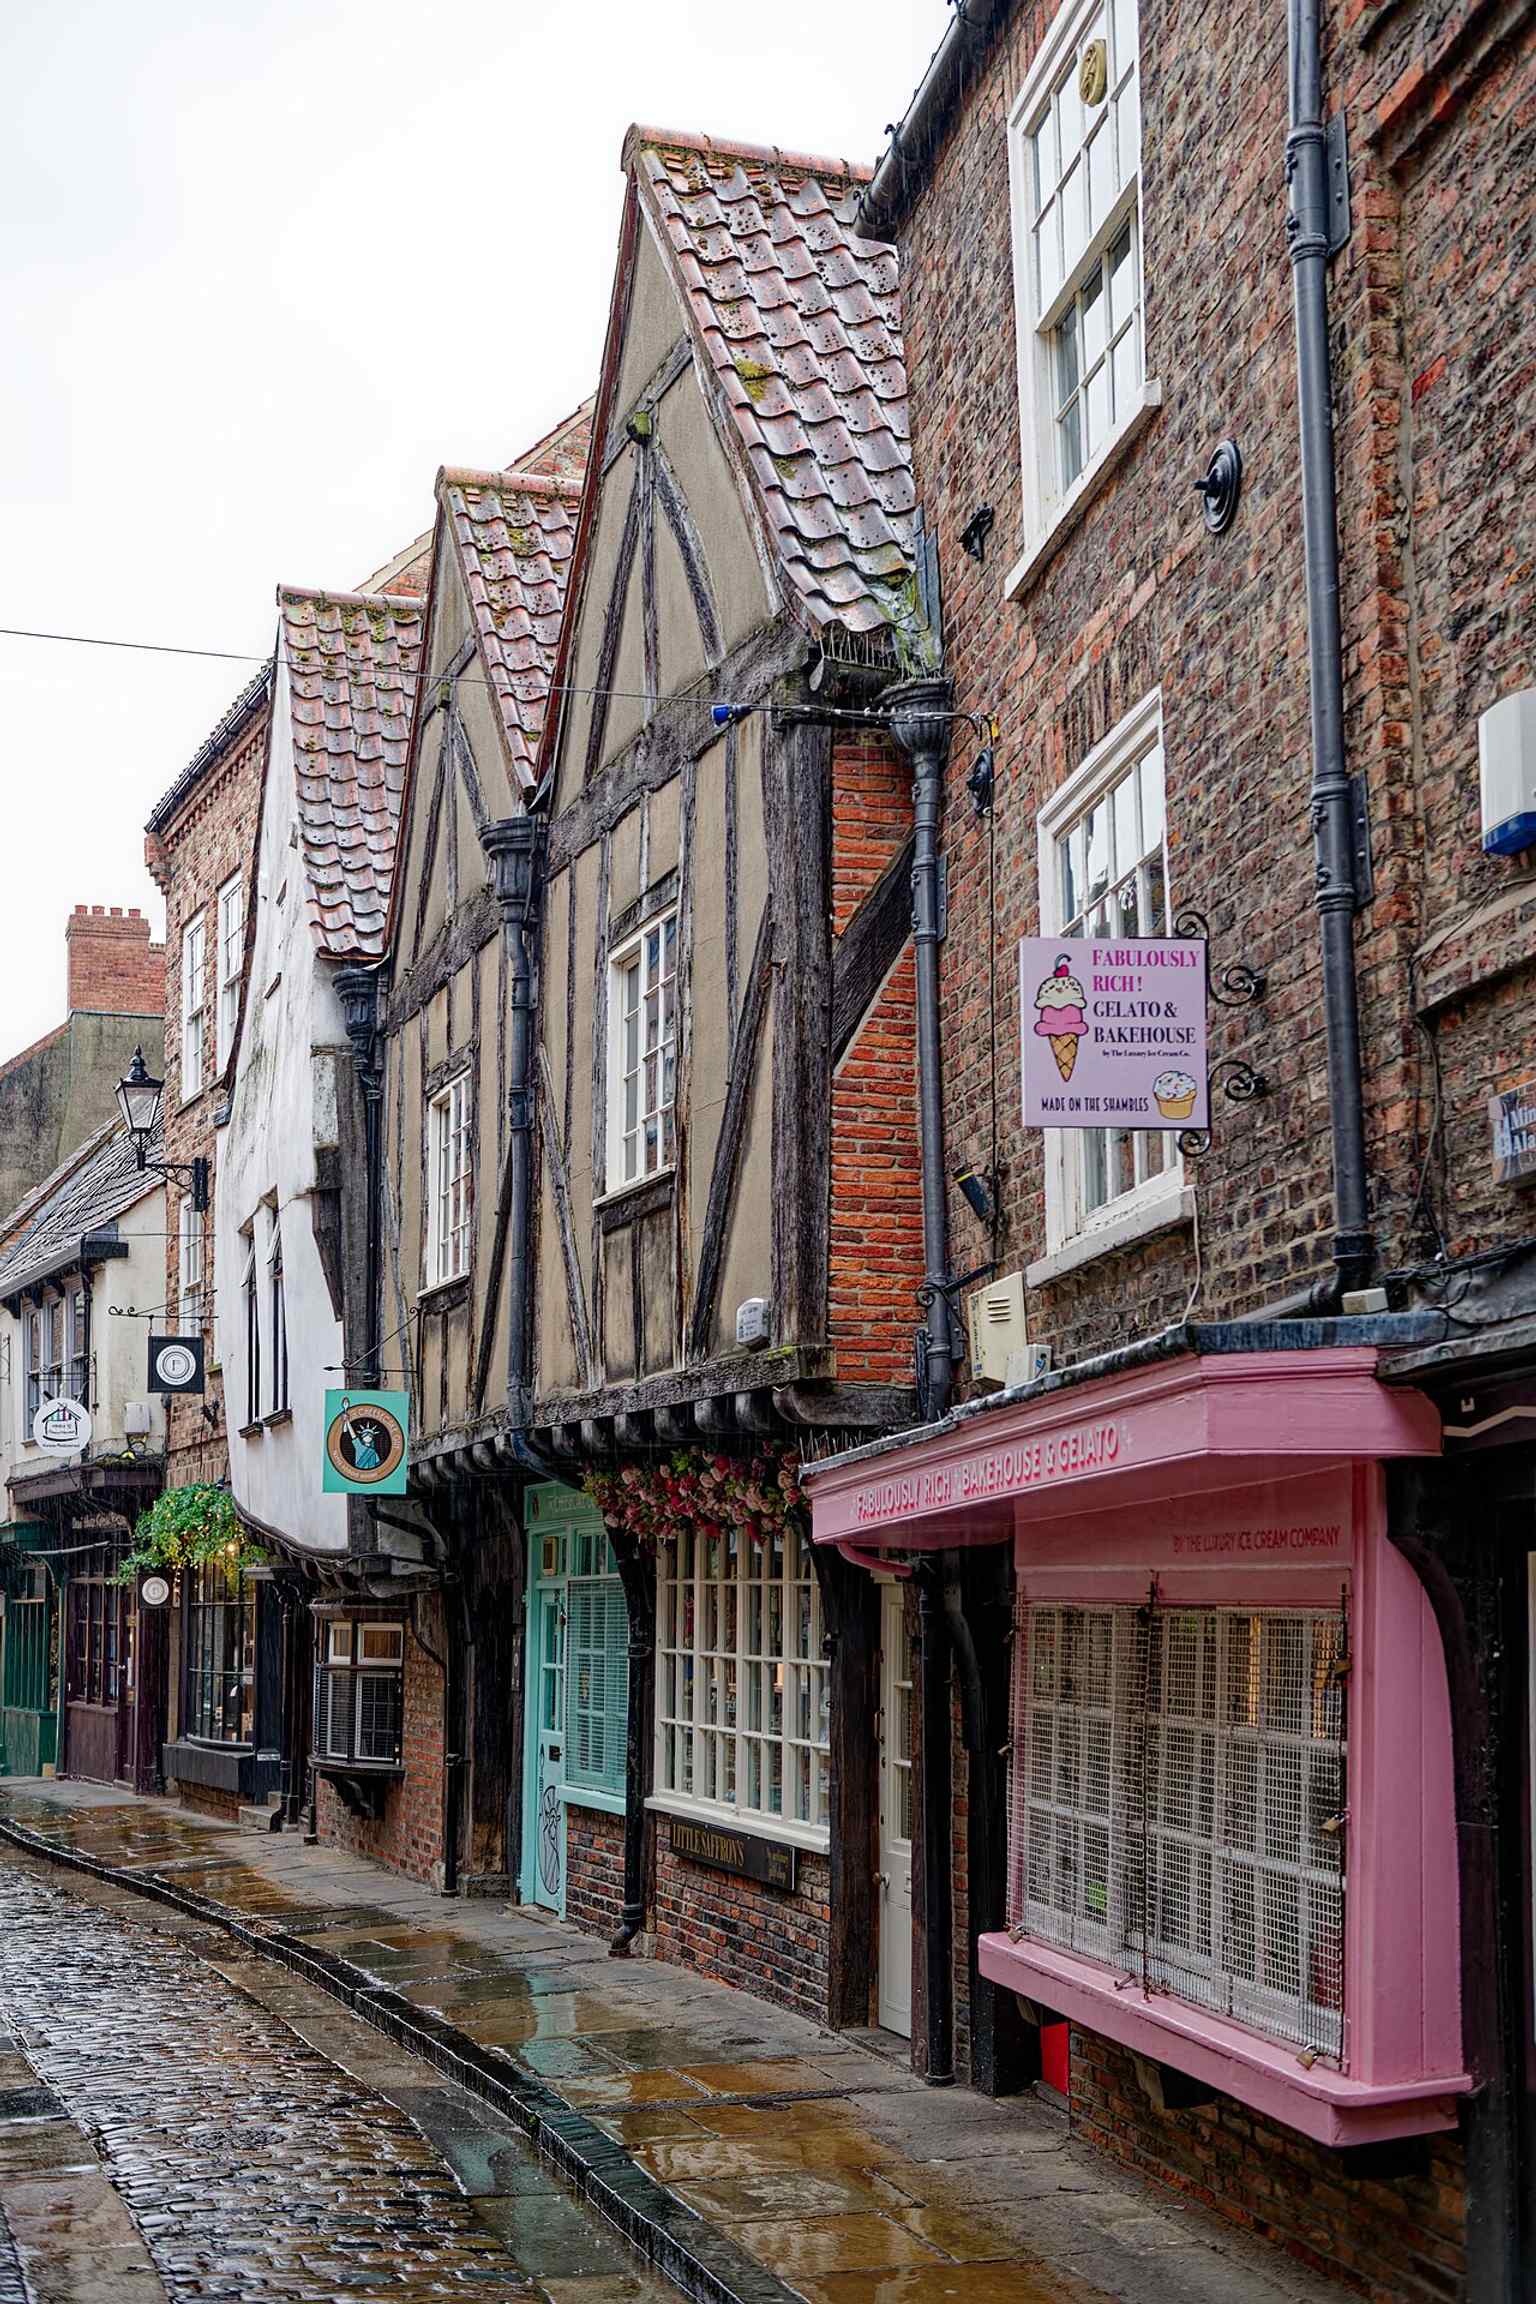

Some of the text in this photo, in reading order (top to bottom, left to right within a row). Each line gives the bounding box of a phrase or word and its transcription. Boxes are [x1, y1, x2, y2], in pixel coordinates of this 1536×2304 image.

[1092, 950, 1200, 968] FABULOUSLY
[1092, 1001, 1178, 1018] GELATO &
[1094, 1026, 1197, 1044] BAKEHOUSE
[1111, 1049, 1123, 1057] The
[1041, 1097, 1150, 1112] MADE ON THE SHAMBLES
[857, 1424, 1121, 1519] FABULOUSLY RICH BAKEHOUSE & GELATO
[1187, 1535, 1201, 1552] THE
[1203, 1532, 1236, 1552] LUXURY
[1239, 1531, 1252, 1550] ICE
[1254, 1529, 1288, 1549] CREAM
[1289, 1526, 1341, 1548] COMPANY
[671, 1823, 700, 1854] LITTLE
